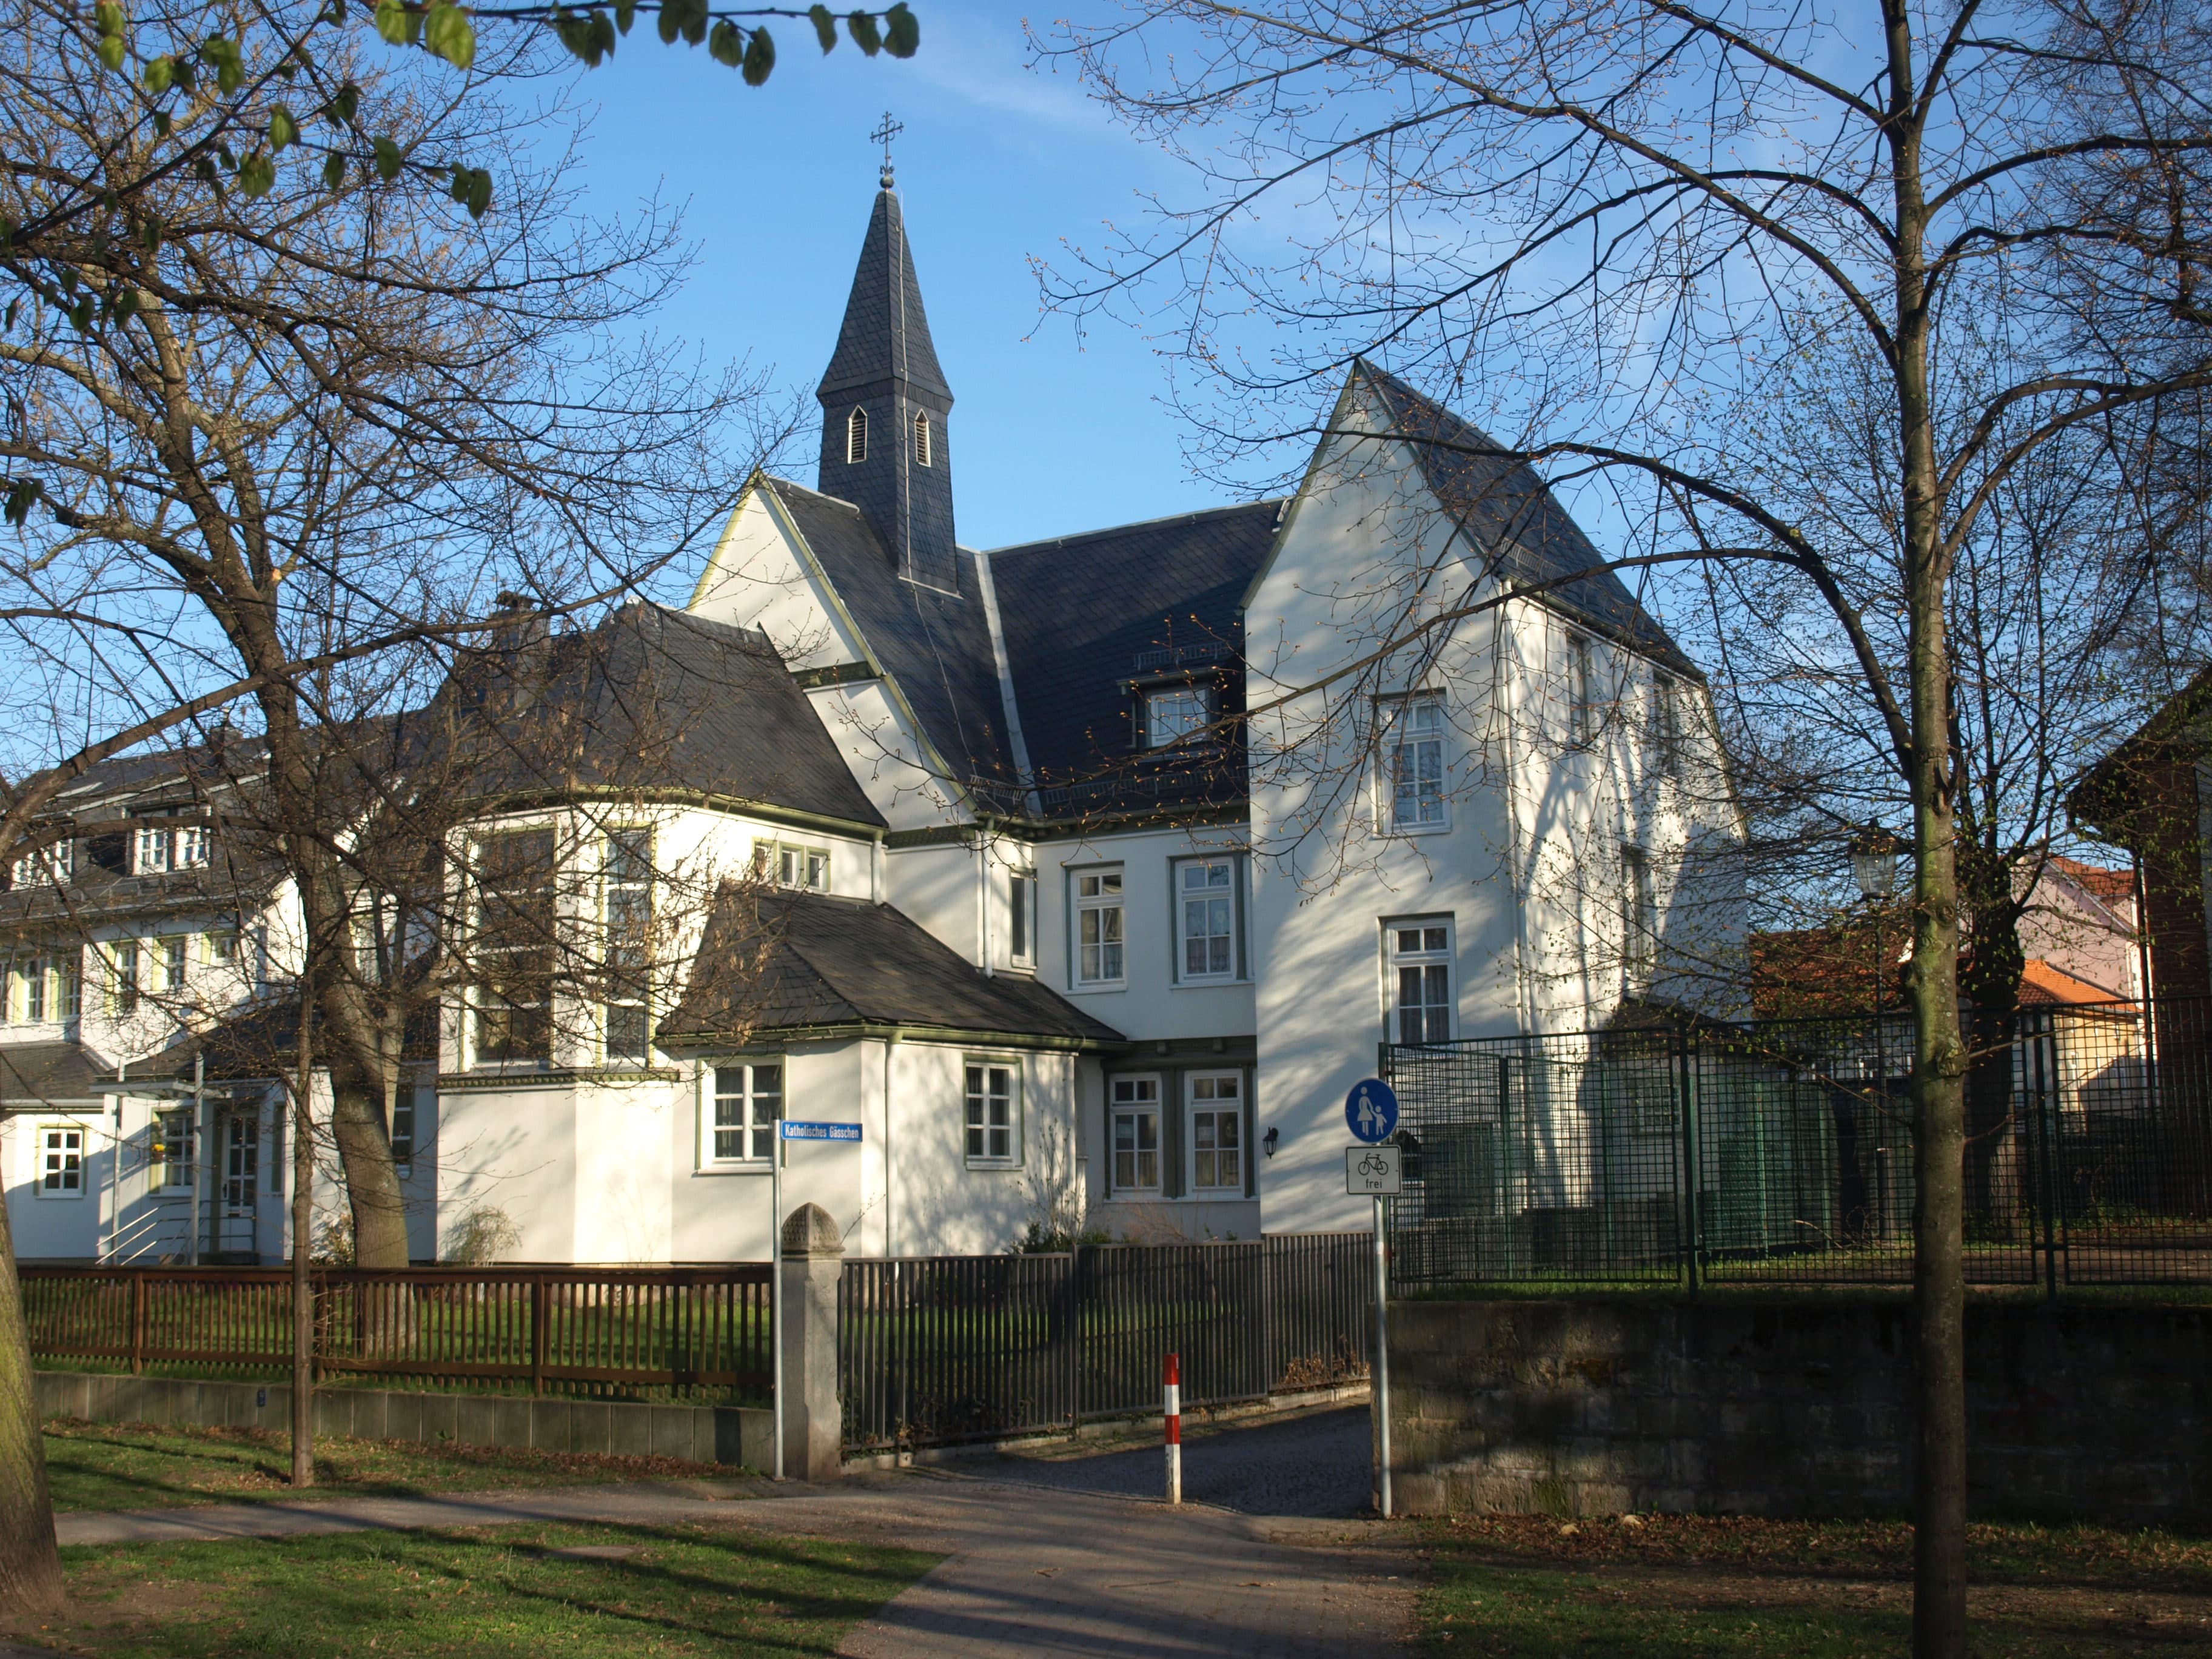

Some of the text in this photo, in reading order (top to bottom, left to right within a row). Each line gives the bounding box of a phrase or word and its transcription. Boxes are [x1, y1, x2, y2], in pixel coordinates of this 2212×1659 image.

[785, 1124, 859, 1138] Katholisches Gässchen
[1366, 1178, 1382, 1188] frei
